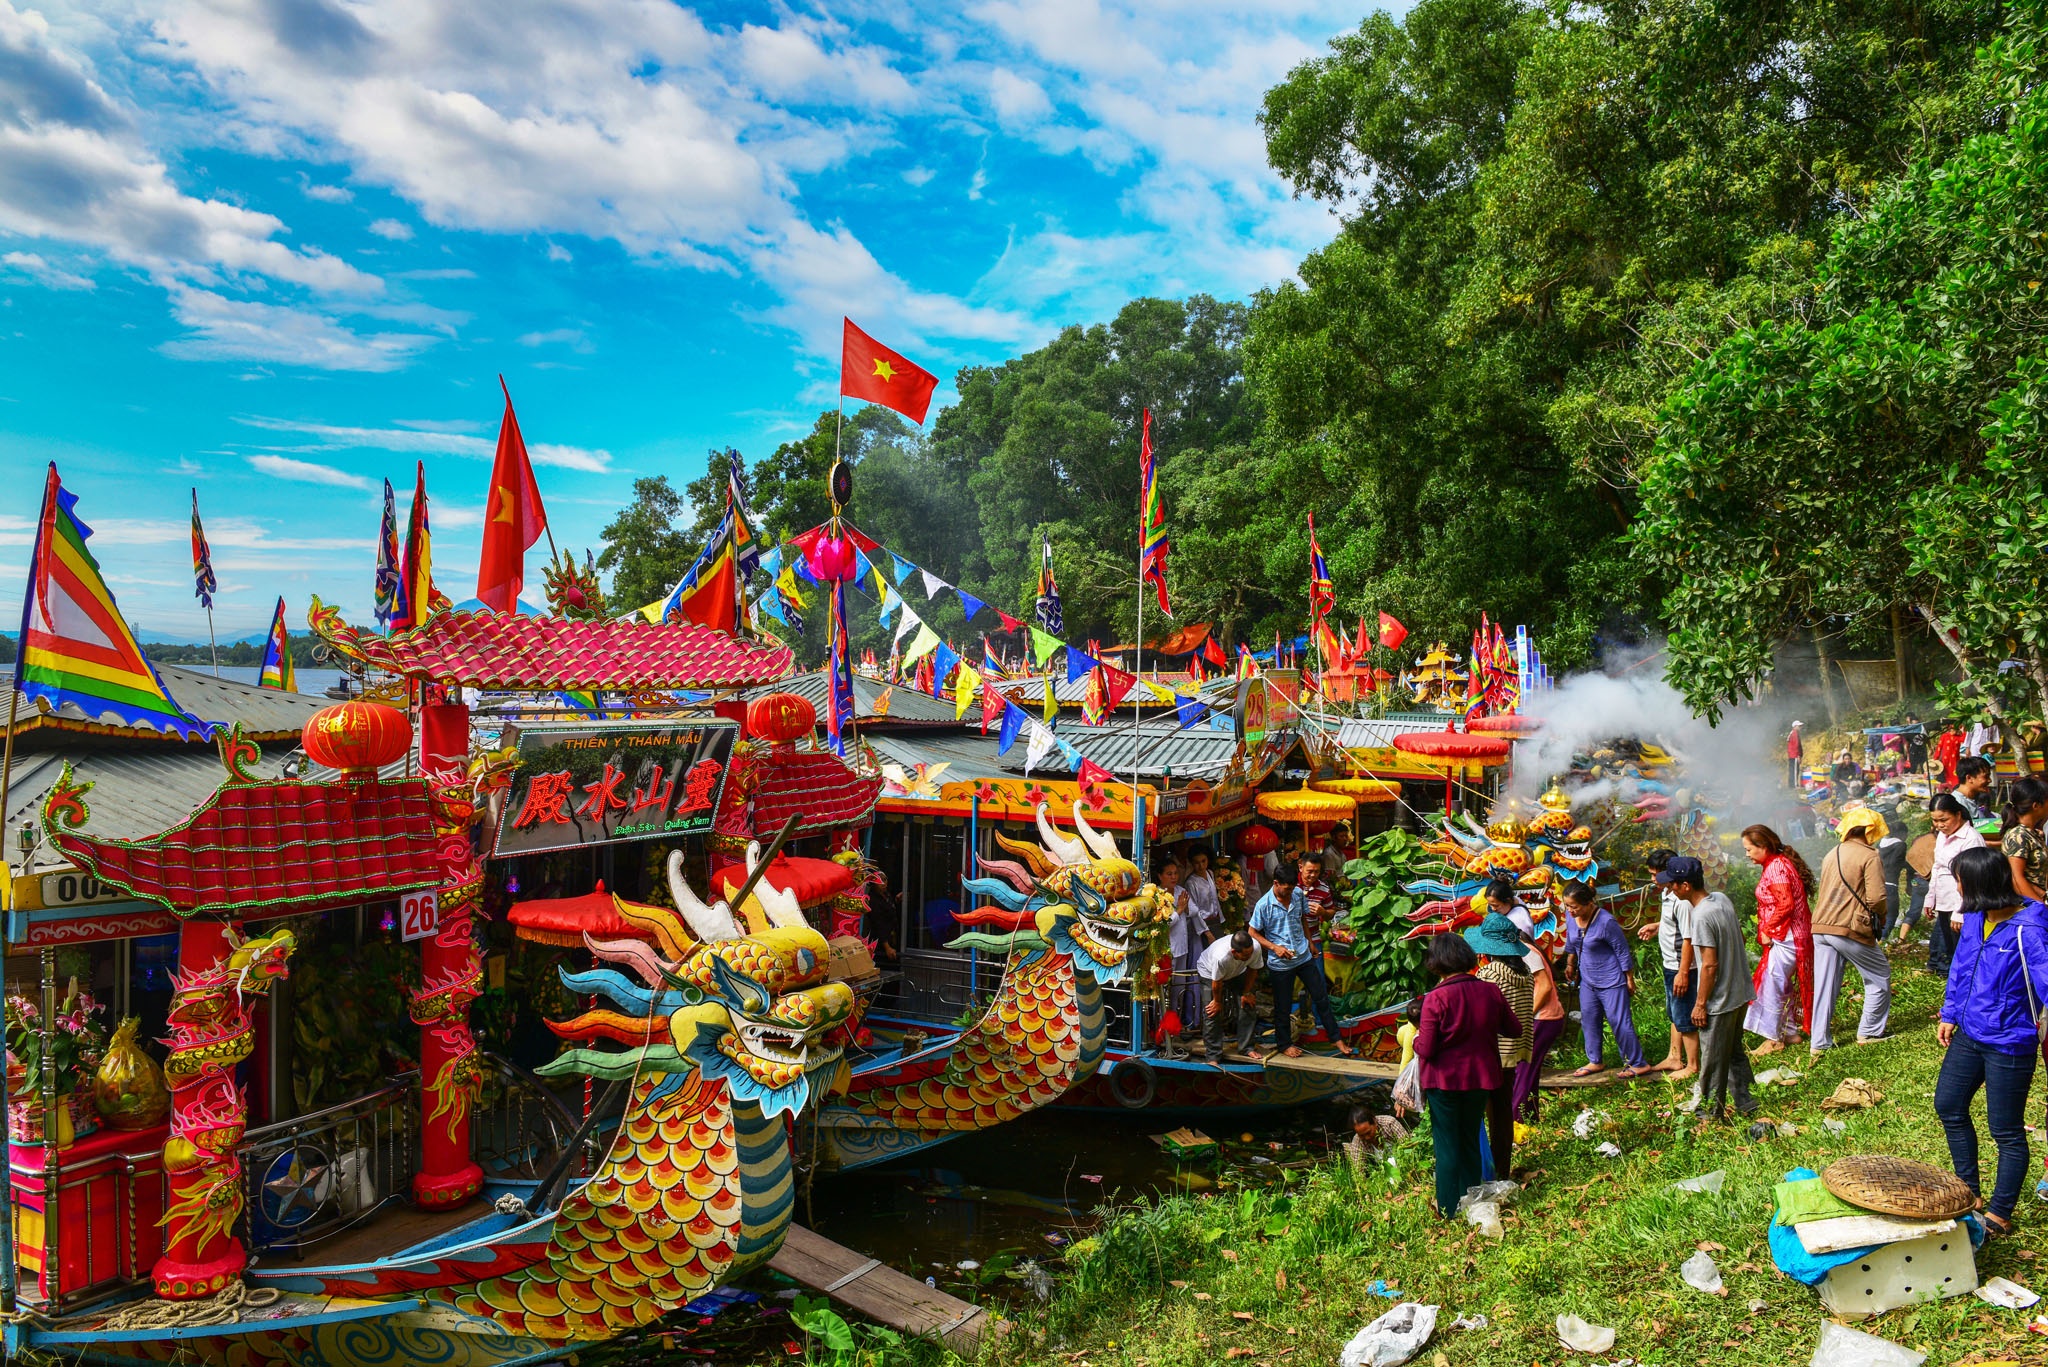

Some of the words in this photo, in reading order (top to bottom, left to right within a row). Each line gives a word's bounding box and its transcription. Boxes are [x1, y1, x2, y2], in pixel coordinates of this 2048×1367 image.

[1246, 693, 1264, 727] 28
[564, 736, 608, 750] THIÊN
[614, 737, 623, 748] Y
[628, 734, 671, 747] THÁNH
[675, 731, 703, 745] MẪU
[691, 816, 710, 826] Nam
[405, 896, 435, 936] 26
